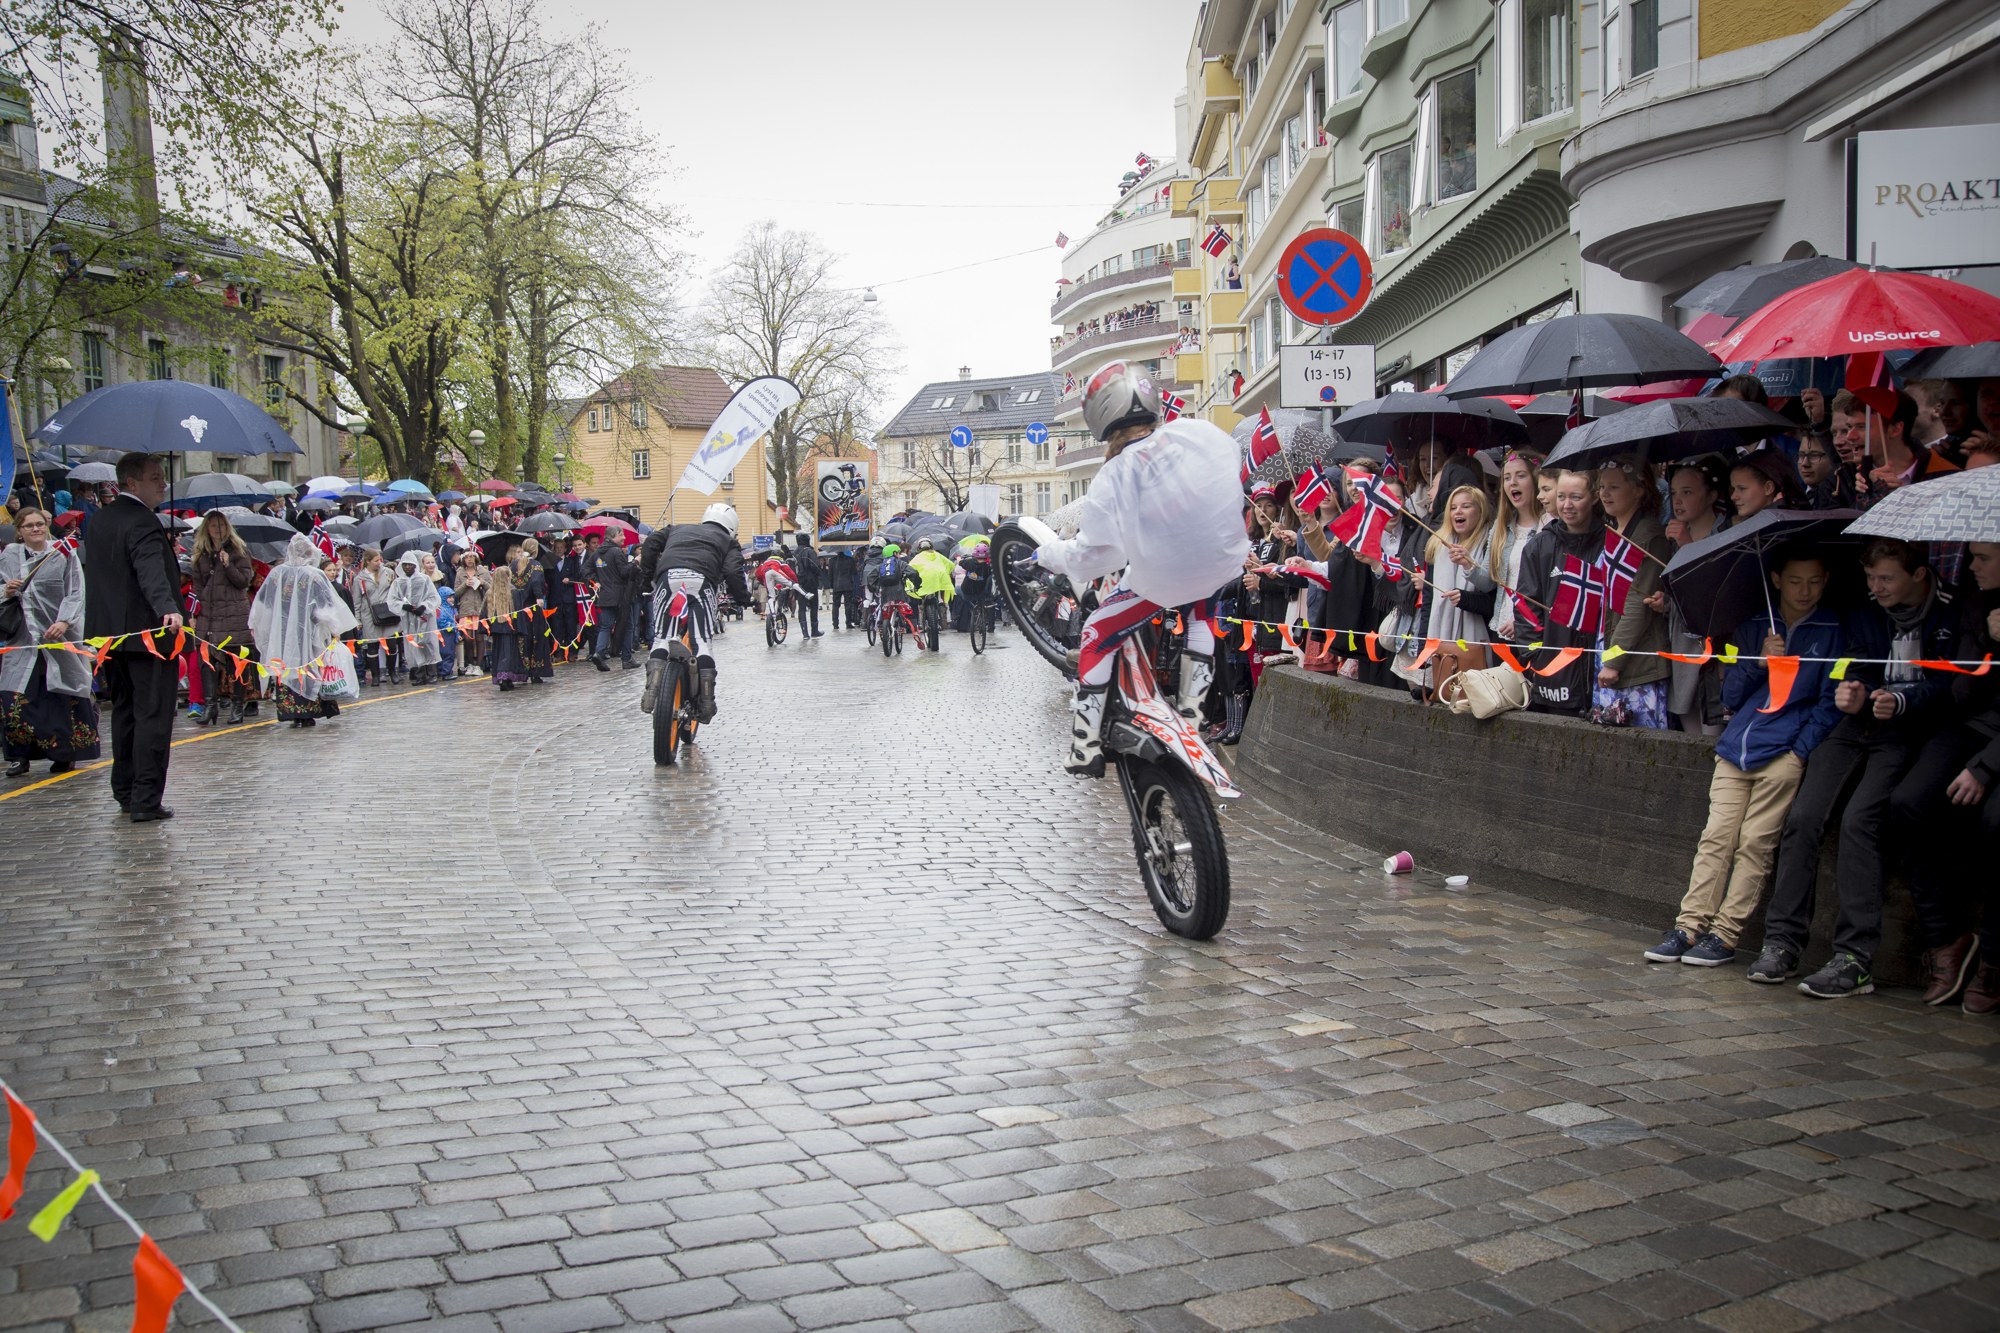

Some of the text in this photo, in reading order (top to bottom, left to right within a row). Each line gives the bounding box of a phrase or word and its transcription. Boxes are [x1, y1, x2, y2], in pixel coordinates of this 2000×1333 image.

[1848, 329, 1941, 344] UpSource
[1760, 373, 1790, 383] norli
[1538, 685, 1569, 703] HMB
